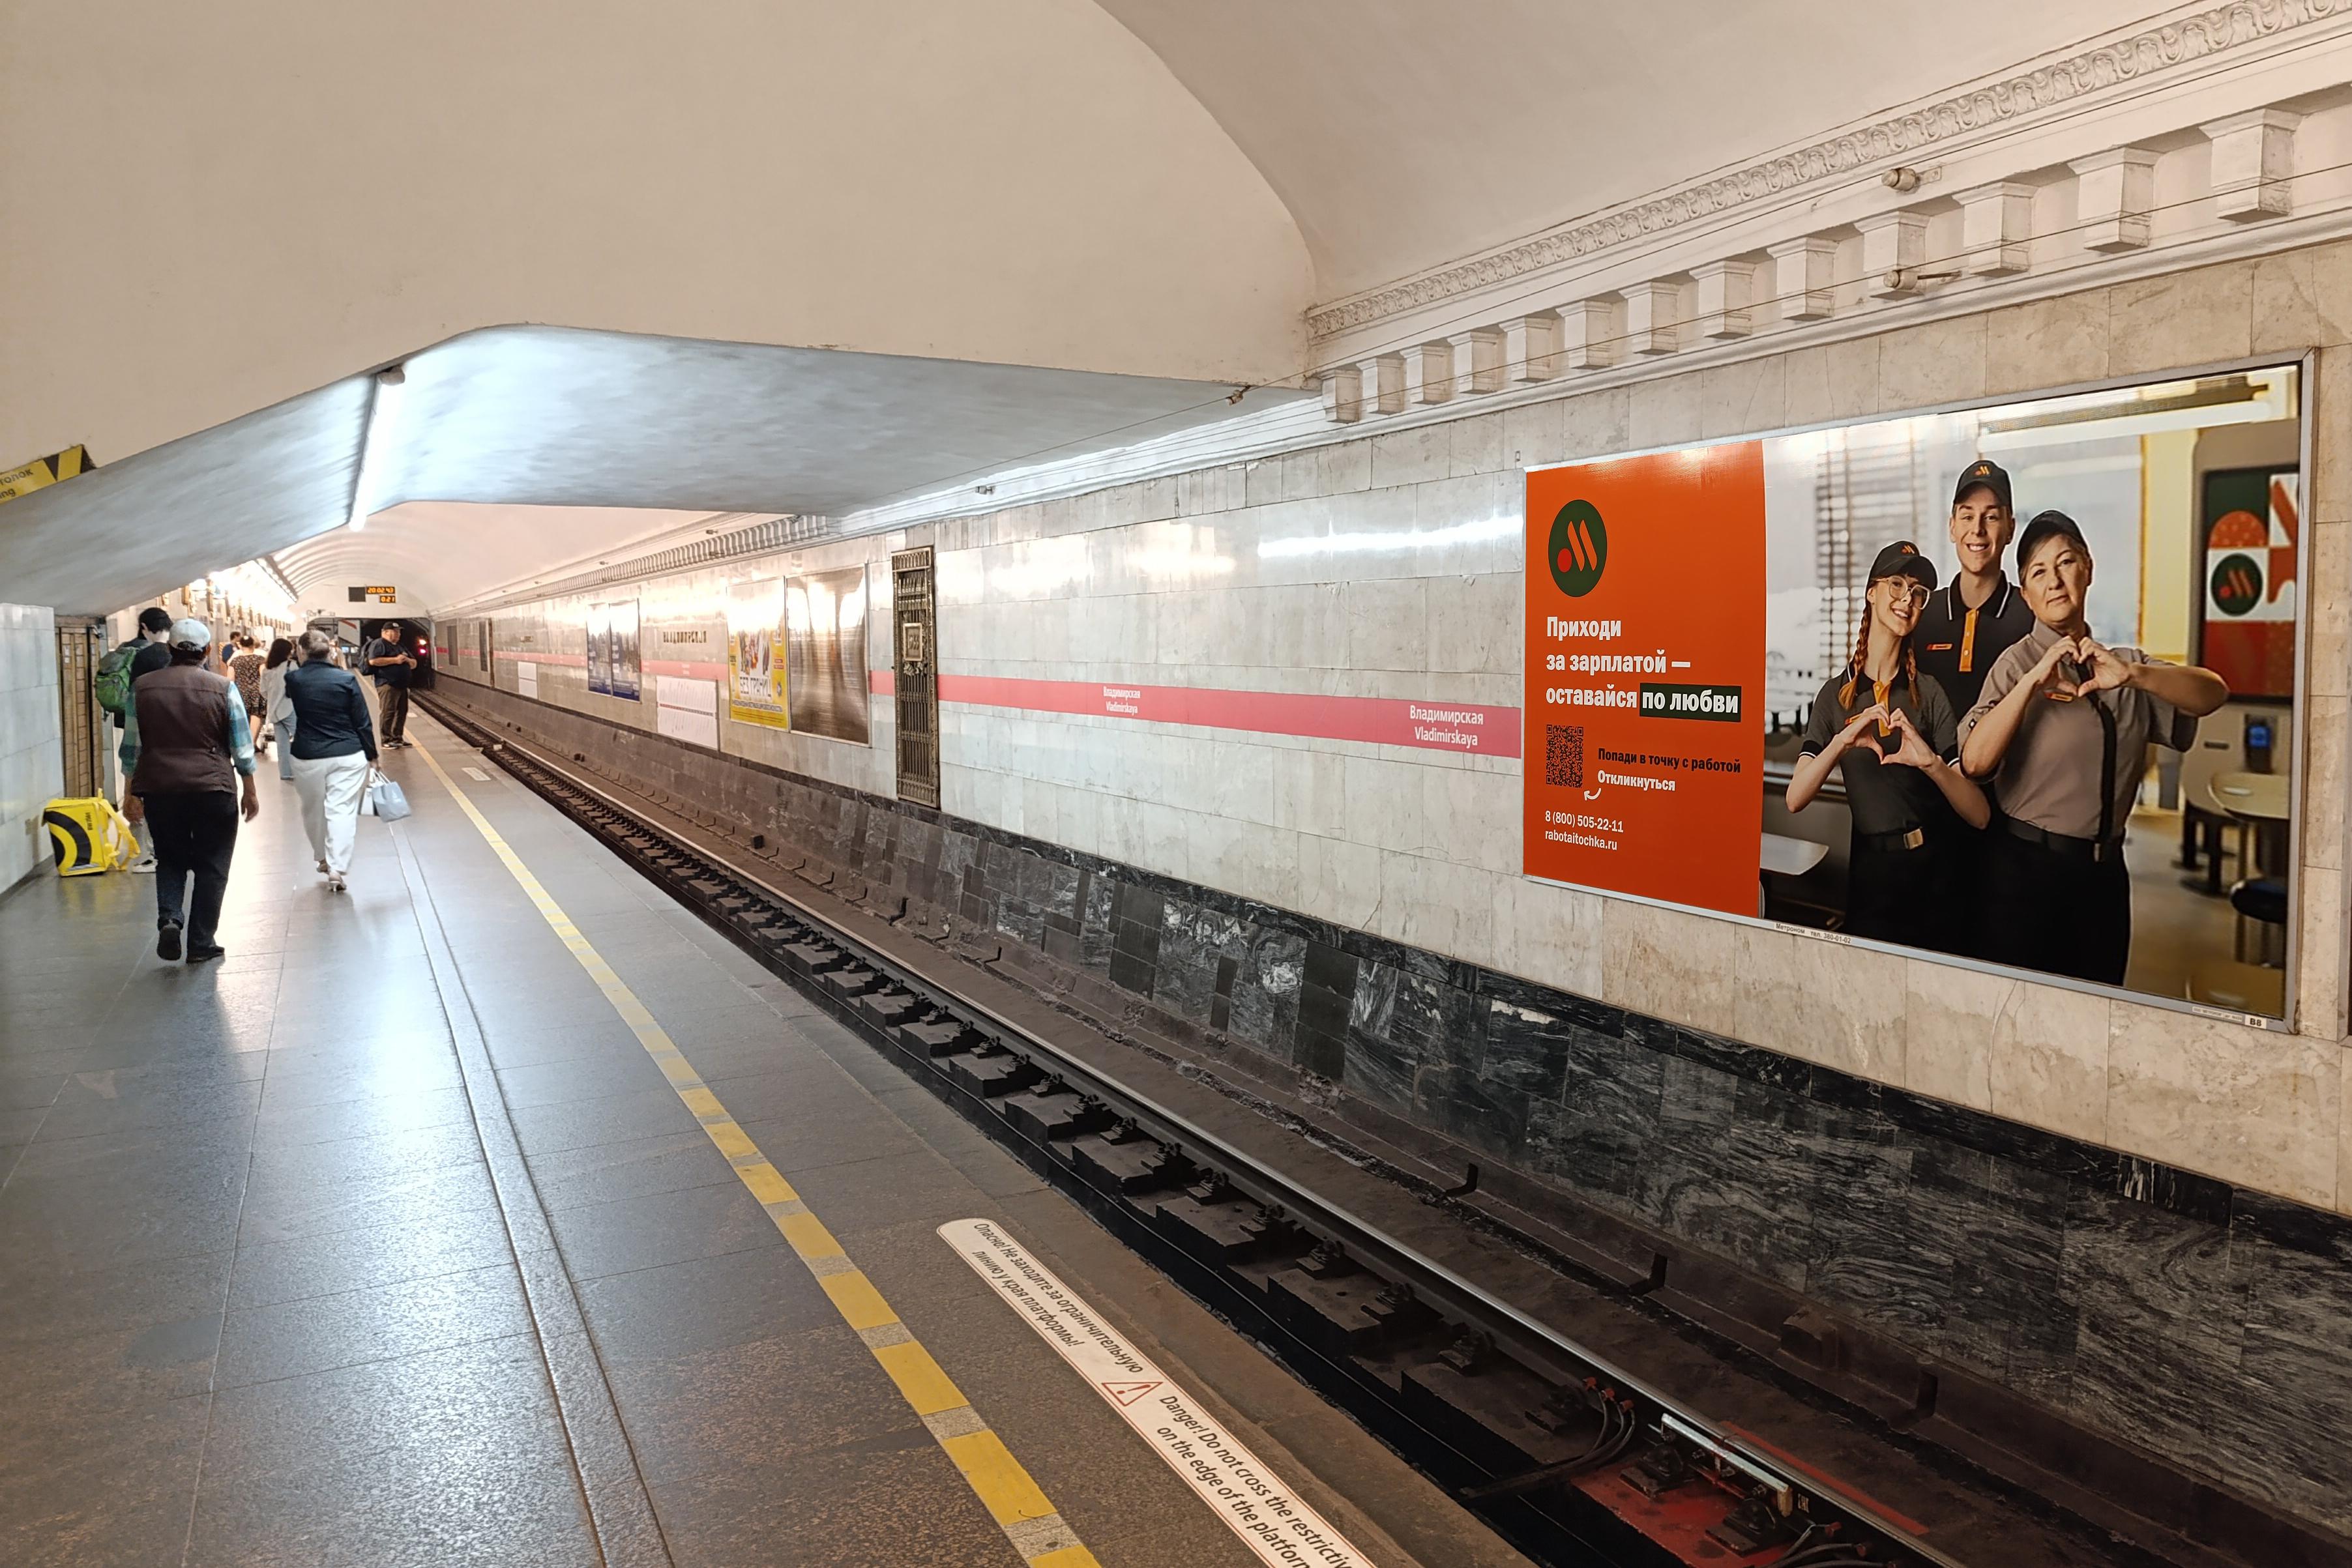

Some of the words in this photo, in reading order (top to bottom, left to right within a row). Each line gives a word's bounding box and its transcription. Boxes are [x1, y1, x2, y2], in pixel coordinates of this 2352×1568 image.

[1547, 616, 1621, 641] Приходи
[1546, 654, 1565, 671] за
[1570, 649, 1666, 676] зарплатой
[1546, 684, 1638, 708] оставайся
[1642, 691, 1666, 709] по
[1669, 690, 1739, 714] любви
[1410, 705, 1484, 727] Владимирская
[1415, 726, 1478, 749] Vladimirskaya
[1598, 748, 1637, 764] Попади
[1639, 754, 1646, 764] в
[1649, 754, 1679, 770] точку
[1682, 758, 1688, 768] с
[1691, 758, 1741, 773] работой
[1597, 770, 1675, 791] Откликнуться
[1545, 810, 1551, 822] 8
[1553, 811, 1576, 828] (800)
[1578, 815, 1624, 833] 505-22-11
[1545, 830, 1617, 850] rabotaitochka.ru
[1776, 923, 1805, 934] Метроном
[1824, 933, 1851, 944] 380-01-02
[971, 1251, 1004, 1274] линию
[1001, 1279, 1029, 1298] края
[1020, 1296, 1085, 1348] платформы!
[974, 1223, 1012, 1249] Опасно!
[1000, 1247, 1018, 1258] Не
[1010, 1257, 1053, 1290] заходите
[1046, 1289, 1063, 1300] за
[1057, 1299, 1143, 1373] ограничительную
[1159, 1396, 1209, 1434] Danger!
[1198, 1432, 1221, 1449] Do
[1214, 1447, 1244, 1468] not
[1235, 1466, 1272, 1496] cross
[1265, 1495, 1293, 1517] the
[1156, 1427, 1177, 1441] on
[1171, 1440, 1196, 1459] the
[1190, 1458, 1224, 1487] edge
[1217, 1485, 1245, 1500] of
[1231, 1499, 1258, 1522] the
